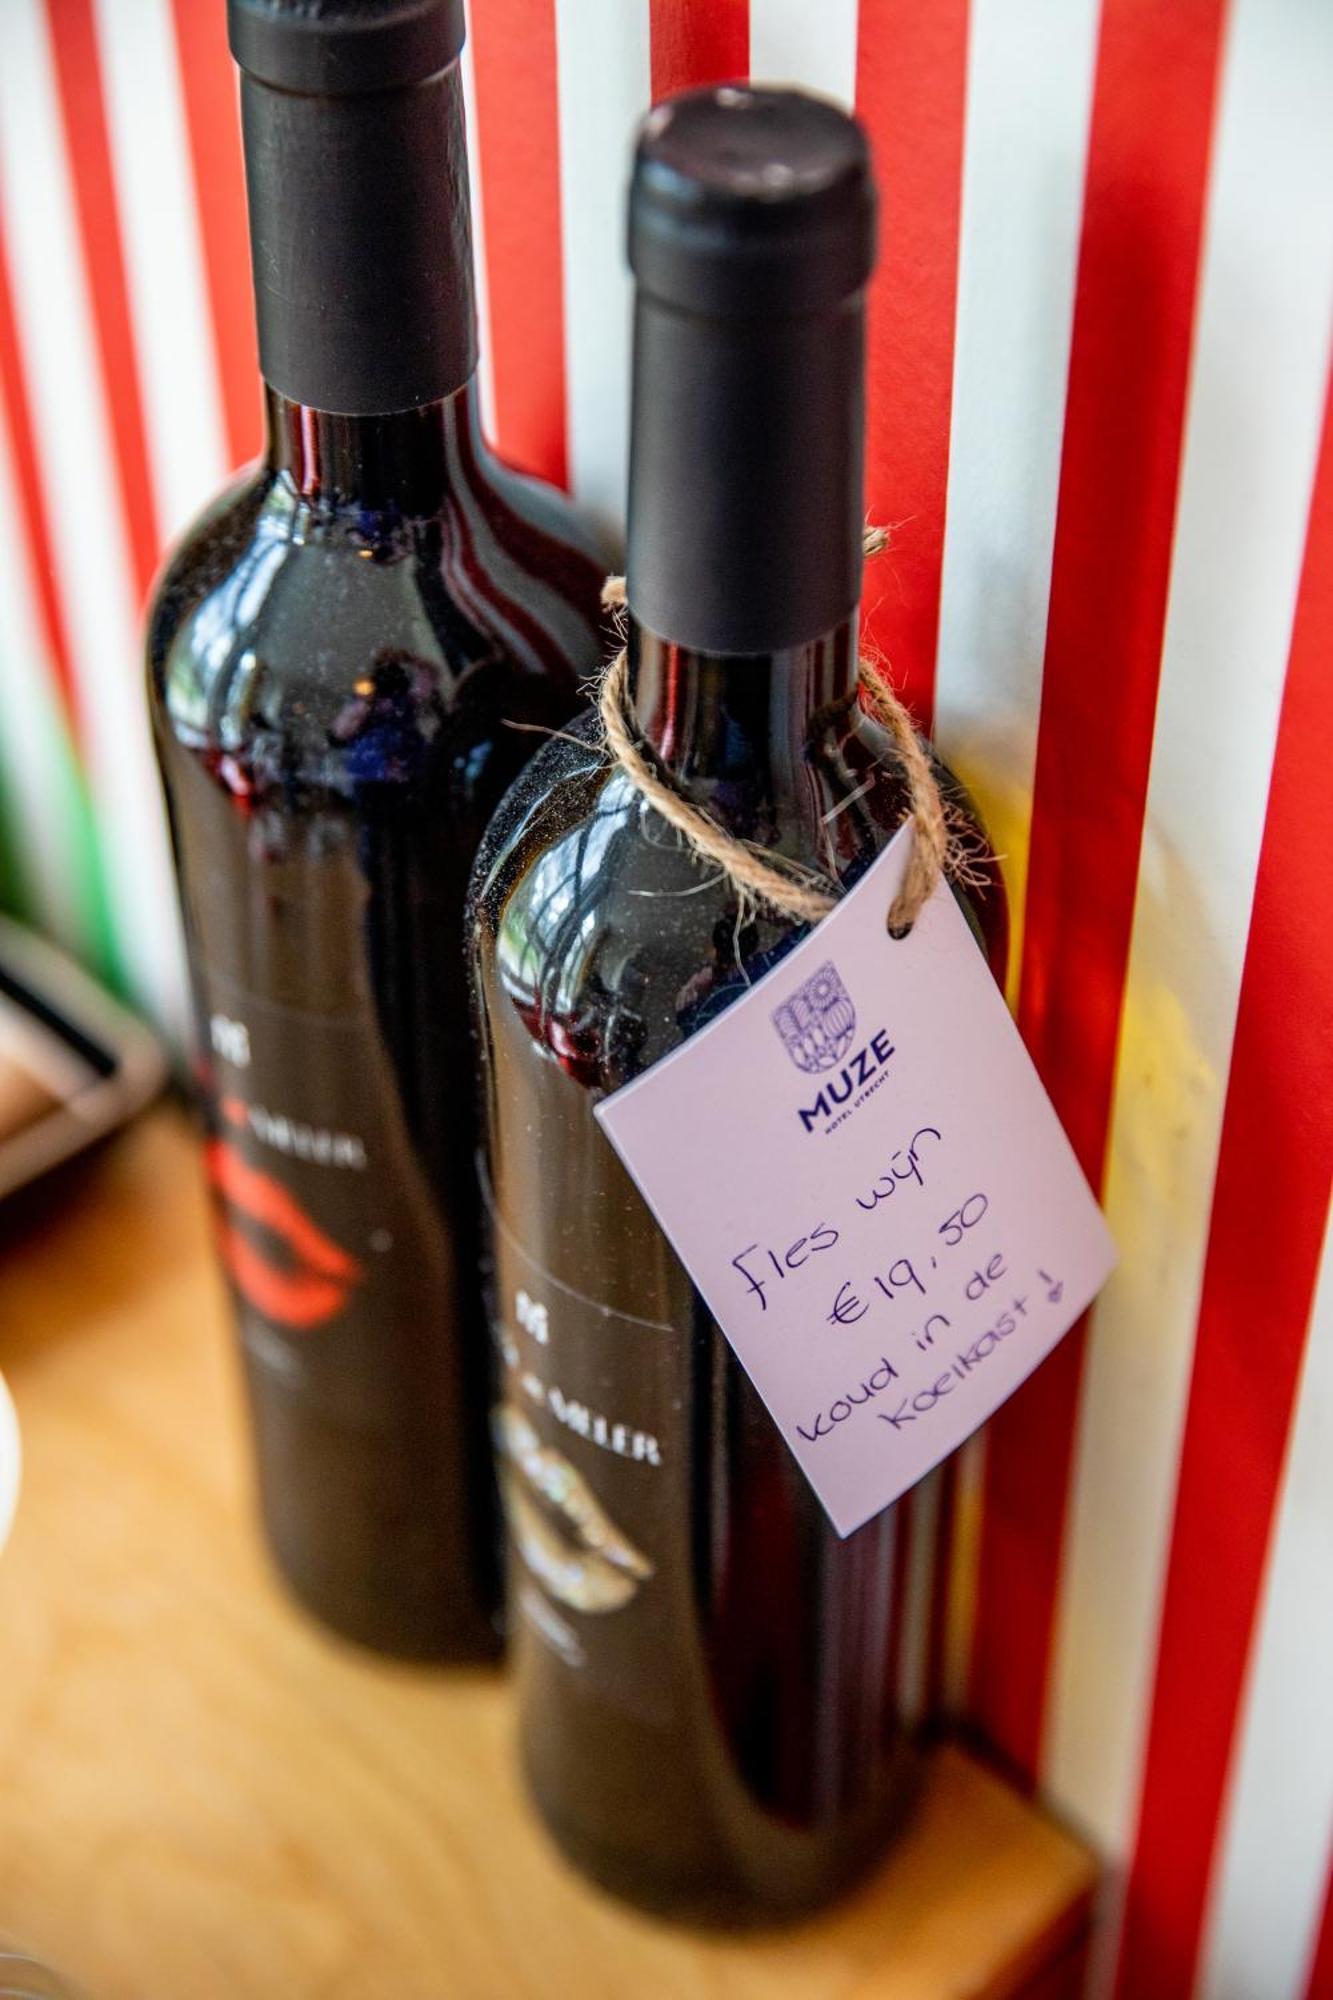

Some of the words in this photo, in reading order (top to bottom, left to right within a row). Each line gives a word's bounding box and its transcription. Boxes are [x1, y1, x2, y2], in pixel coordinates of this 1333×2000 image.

[797, 1027, 897, 1134] MUZE
[824, 1108, 853, 1135] HOTEL
[853, 1069, 892, 1109] UTRECHT
[911, 1313, 951, 1351] in
[965, 1252, 1008, 1301] de
